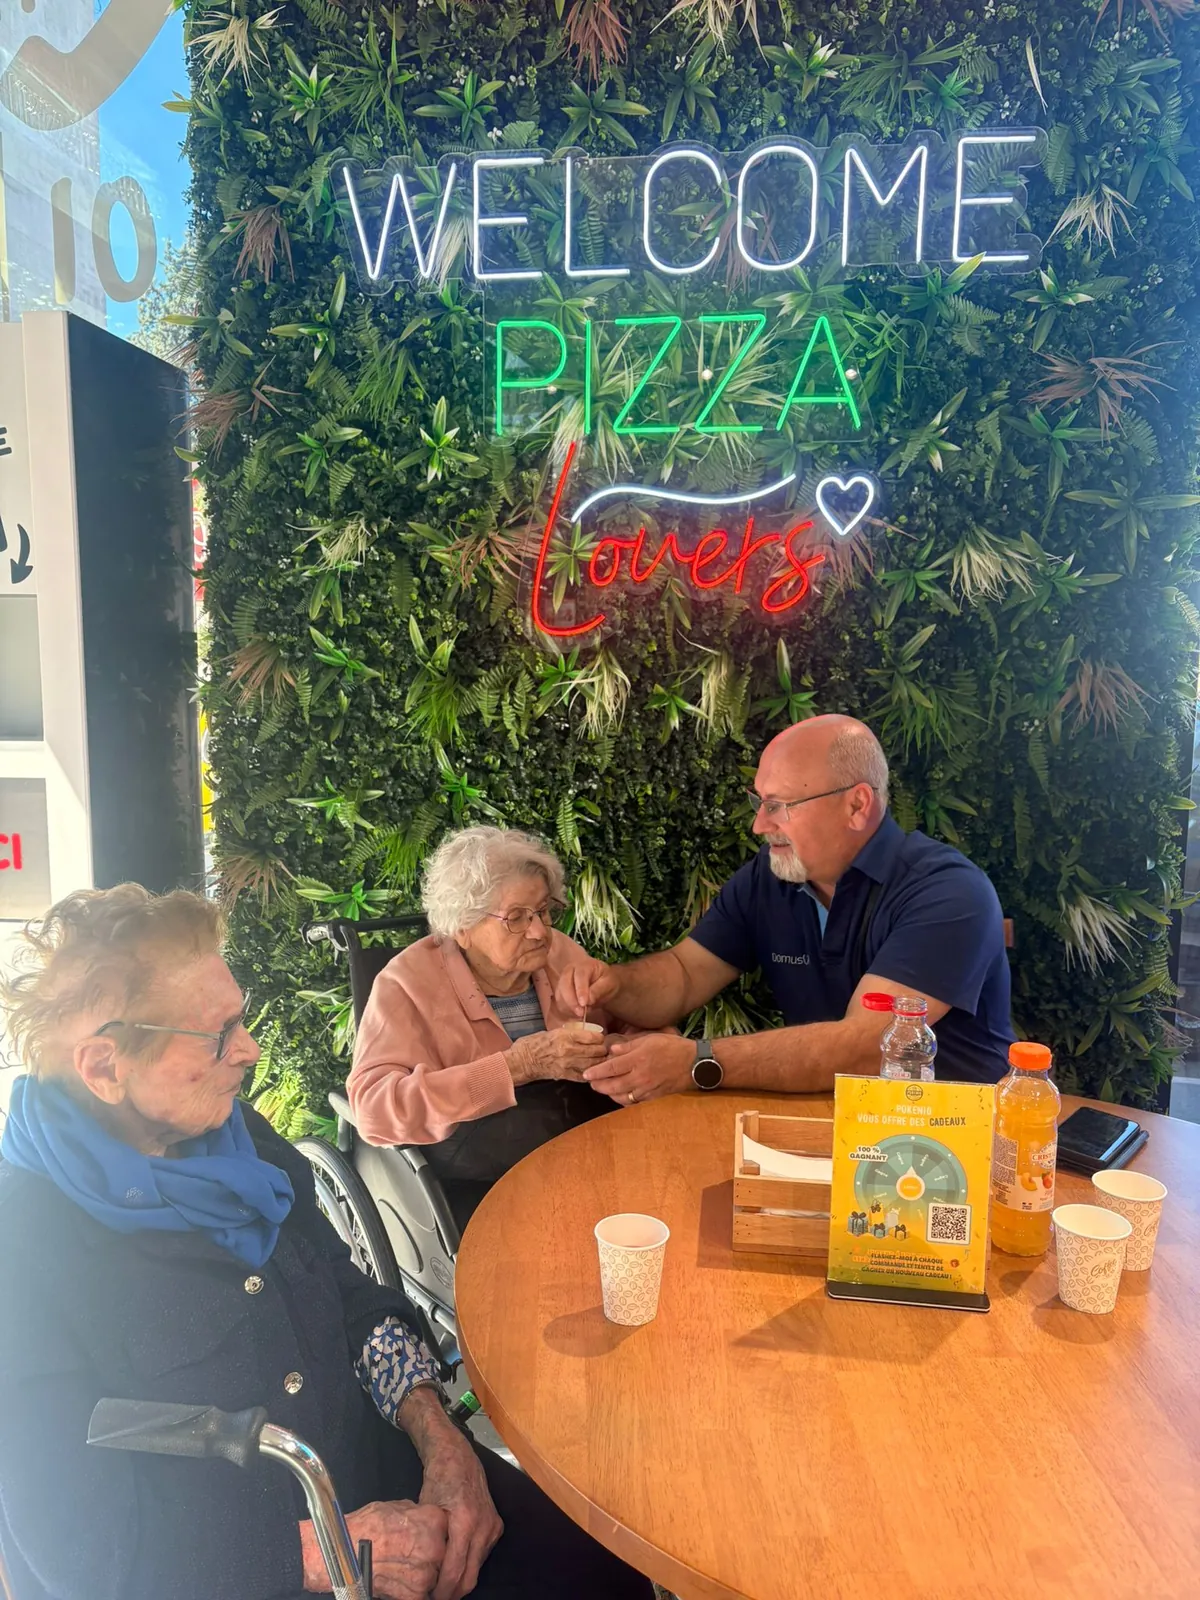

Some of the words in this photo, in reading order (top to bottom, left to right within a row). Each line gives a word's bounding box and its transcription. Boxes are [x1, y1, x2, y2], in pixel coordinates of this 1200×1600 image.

[342, 134, 1036, 282] WELCOME
[495, 313, 862, 436] PIZZA
[531, 441, 826, 637] Lovers
[857, 1114, 879, 1123] VOUS
[881, 1116, 906, 1126] OFFRE
[909, 1118, 925, 1127] DES
[929, 1116, 966, 1127] CADEAUX
[896, 1104, 932, 1116] POKENIO
[849, 1152, 887, 1161] GAGNANT
